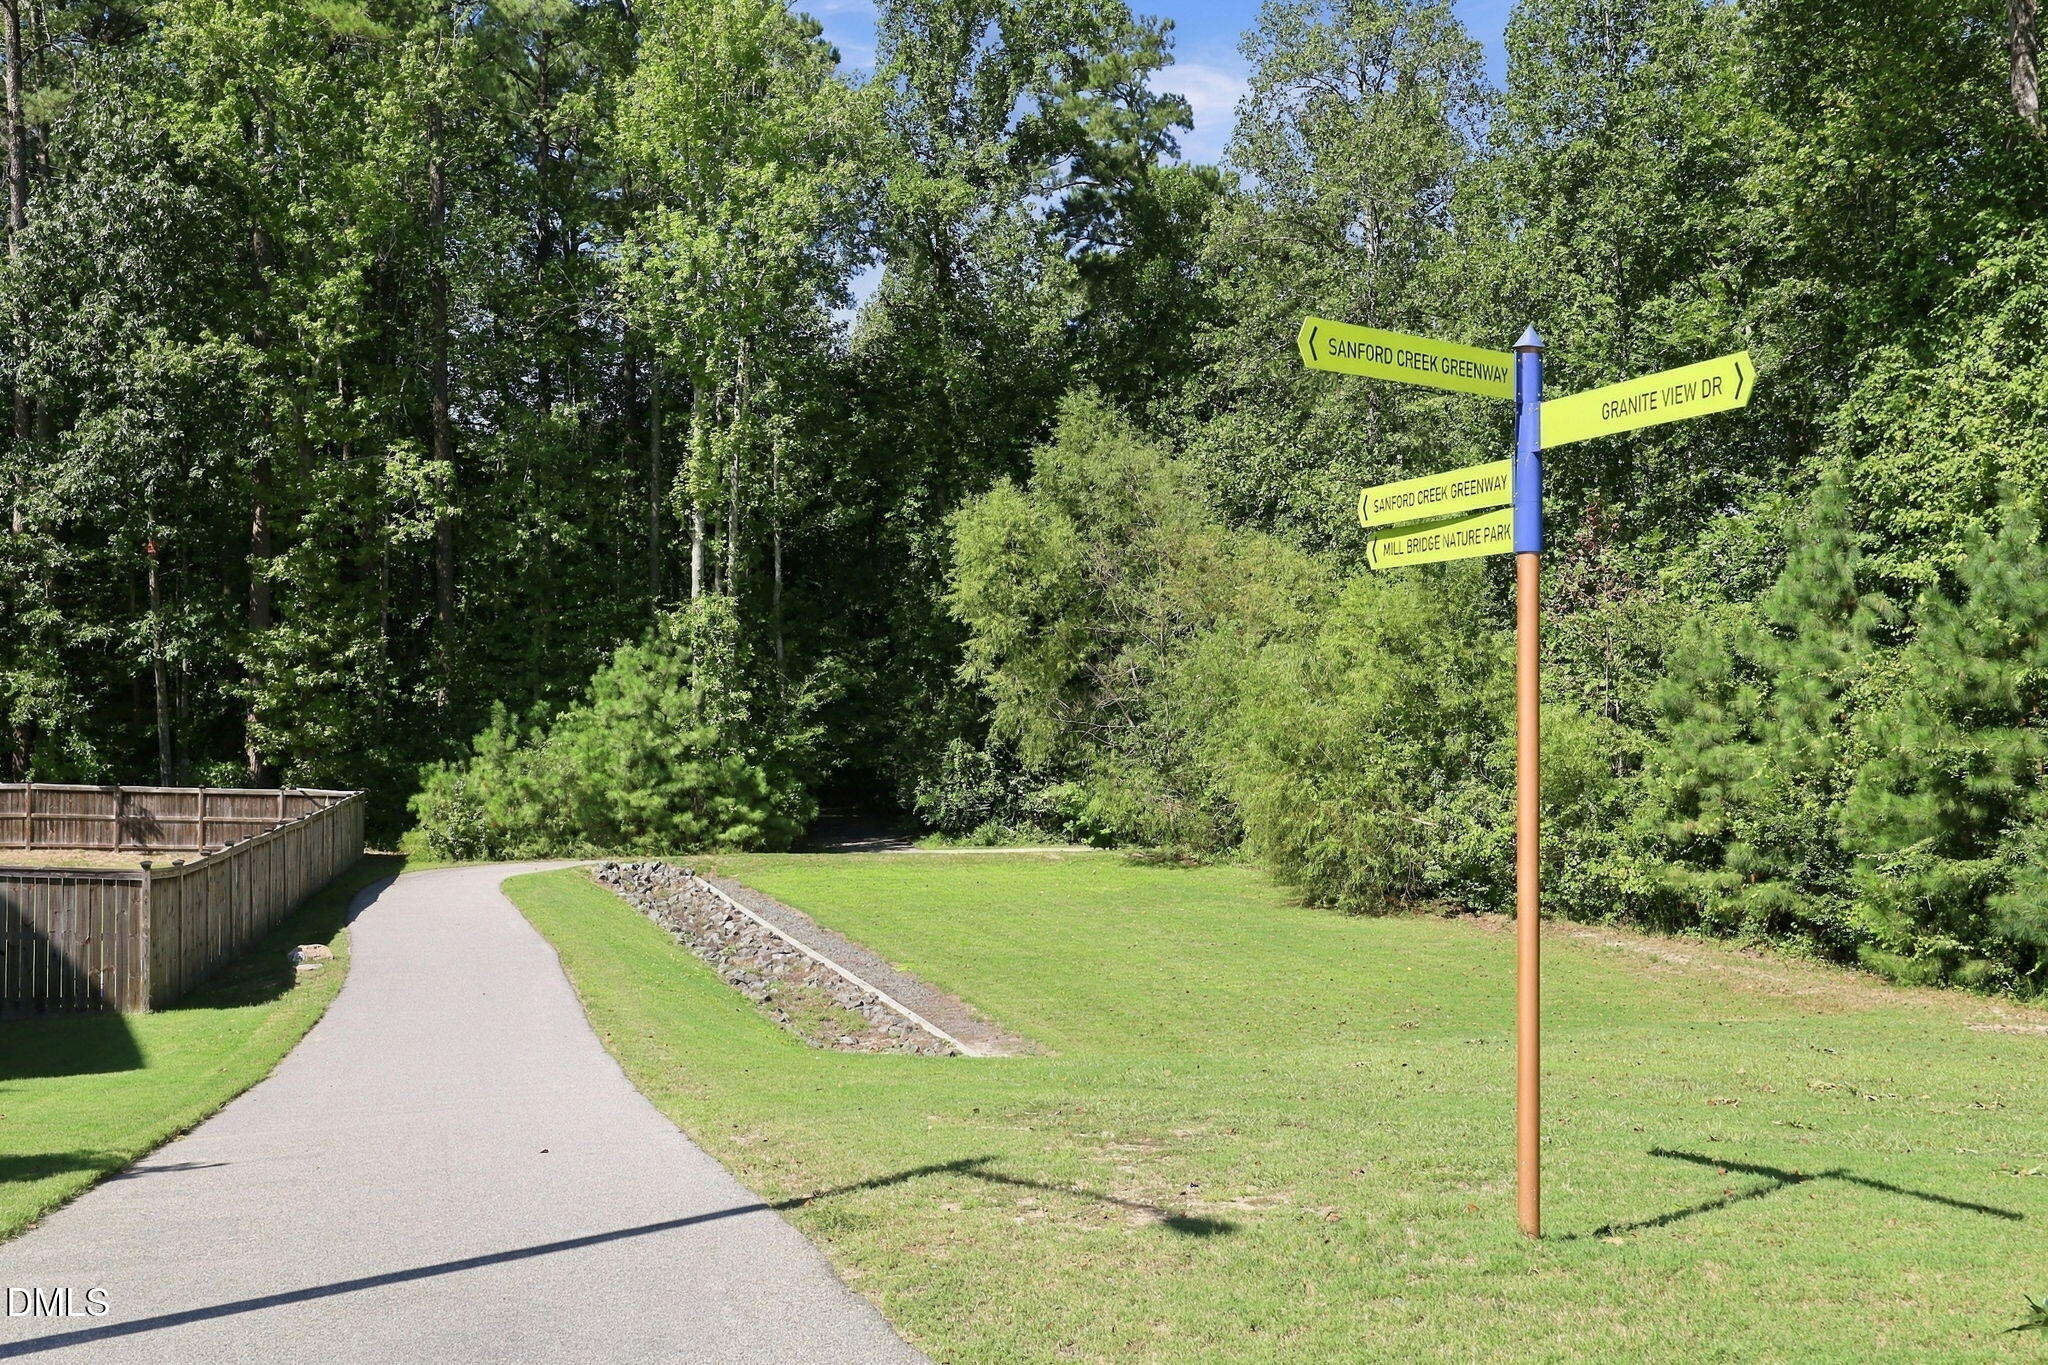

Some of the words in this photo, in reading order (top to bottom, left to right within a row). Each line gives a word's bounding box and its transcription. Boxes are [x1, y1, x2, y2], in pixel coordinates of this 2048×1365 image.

[1328, 337, 1393, 365] SANFORD
[1396, 350, 1439, 373] CREEK
[1441, 357, 1508, 384] GREENWAY
[1602, 391, 1658, 420] GRANITE
[1661, 382, 1697, 408] VIEW
[1701, 376, 1723, 399] DR
[1373, 493, 1415, 513] SANFORD
[1417, 485, 1448, 505] CREEK
[1450, 474, 1508, 499] GREENWAY
[1383, 540, 1404, 557] MILL
[1406, 534, 1440, 554] BRIDGE
[1442, 528, 1481, 548] NATURE
[1483, 523, 1511, 543] PARK
